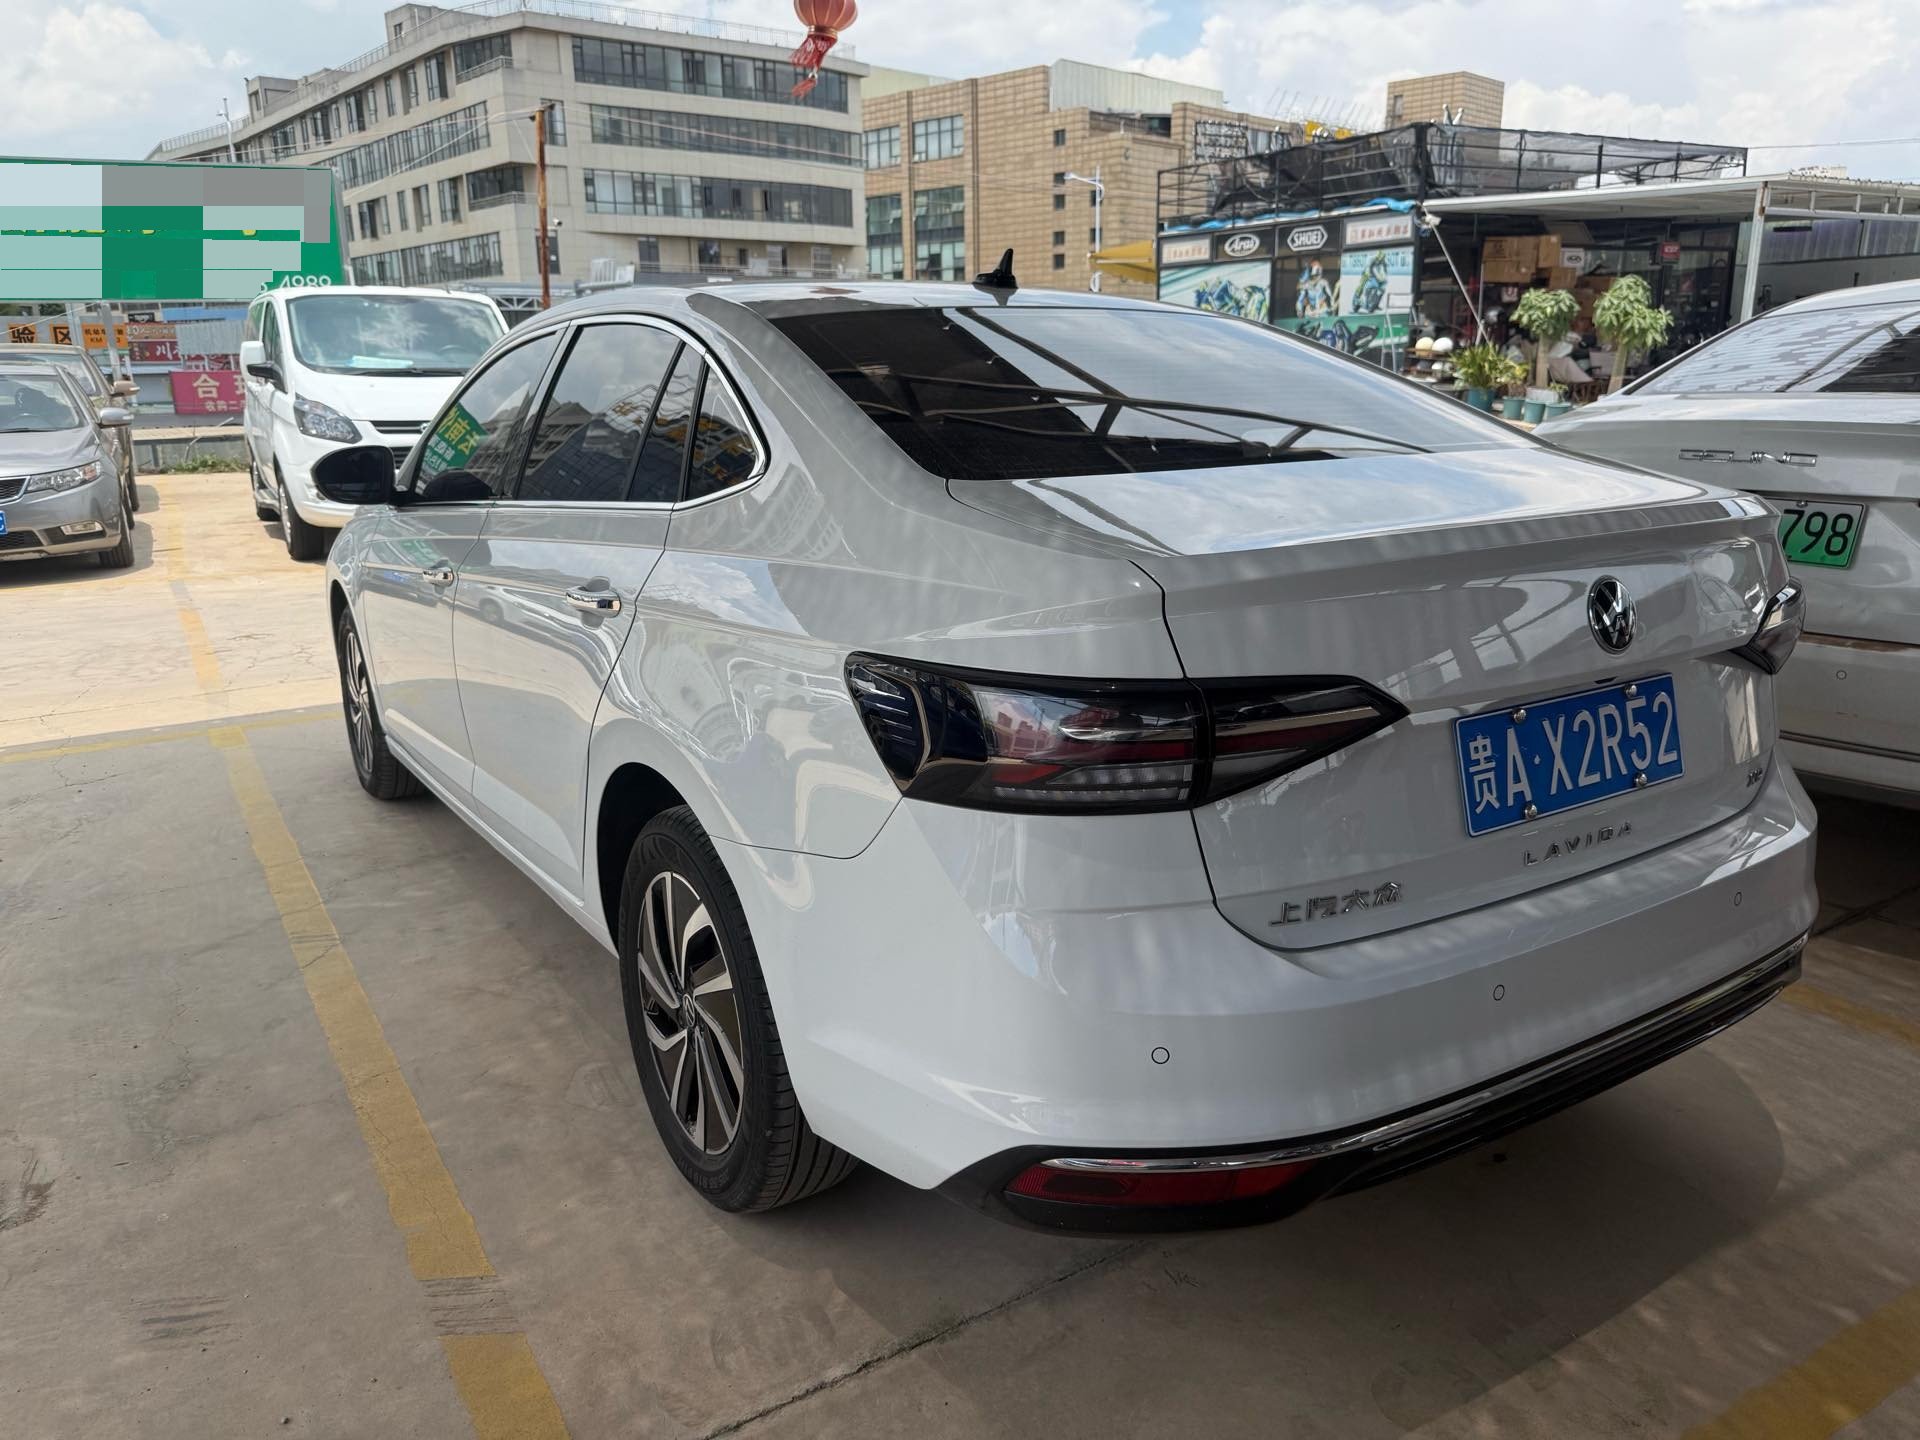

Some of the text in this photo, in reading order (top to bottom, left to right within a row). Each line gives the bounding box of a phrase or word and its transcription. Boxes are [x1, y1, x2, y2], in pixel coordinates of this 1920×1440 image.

[1293, 230, 1322, 247] SHOEI
[1523, 820, 1632, 867] LAVIDA
[1269, 881, 1402, 927] 上汽大众
